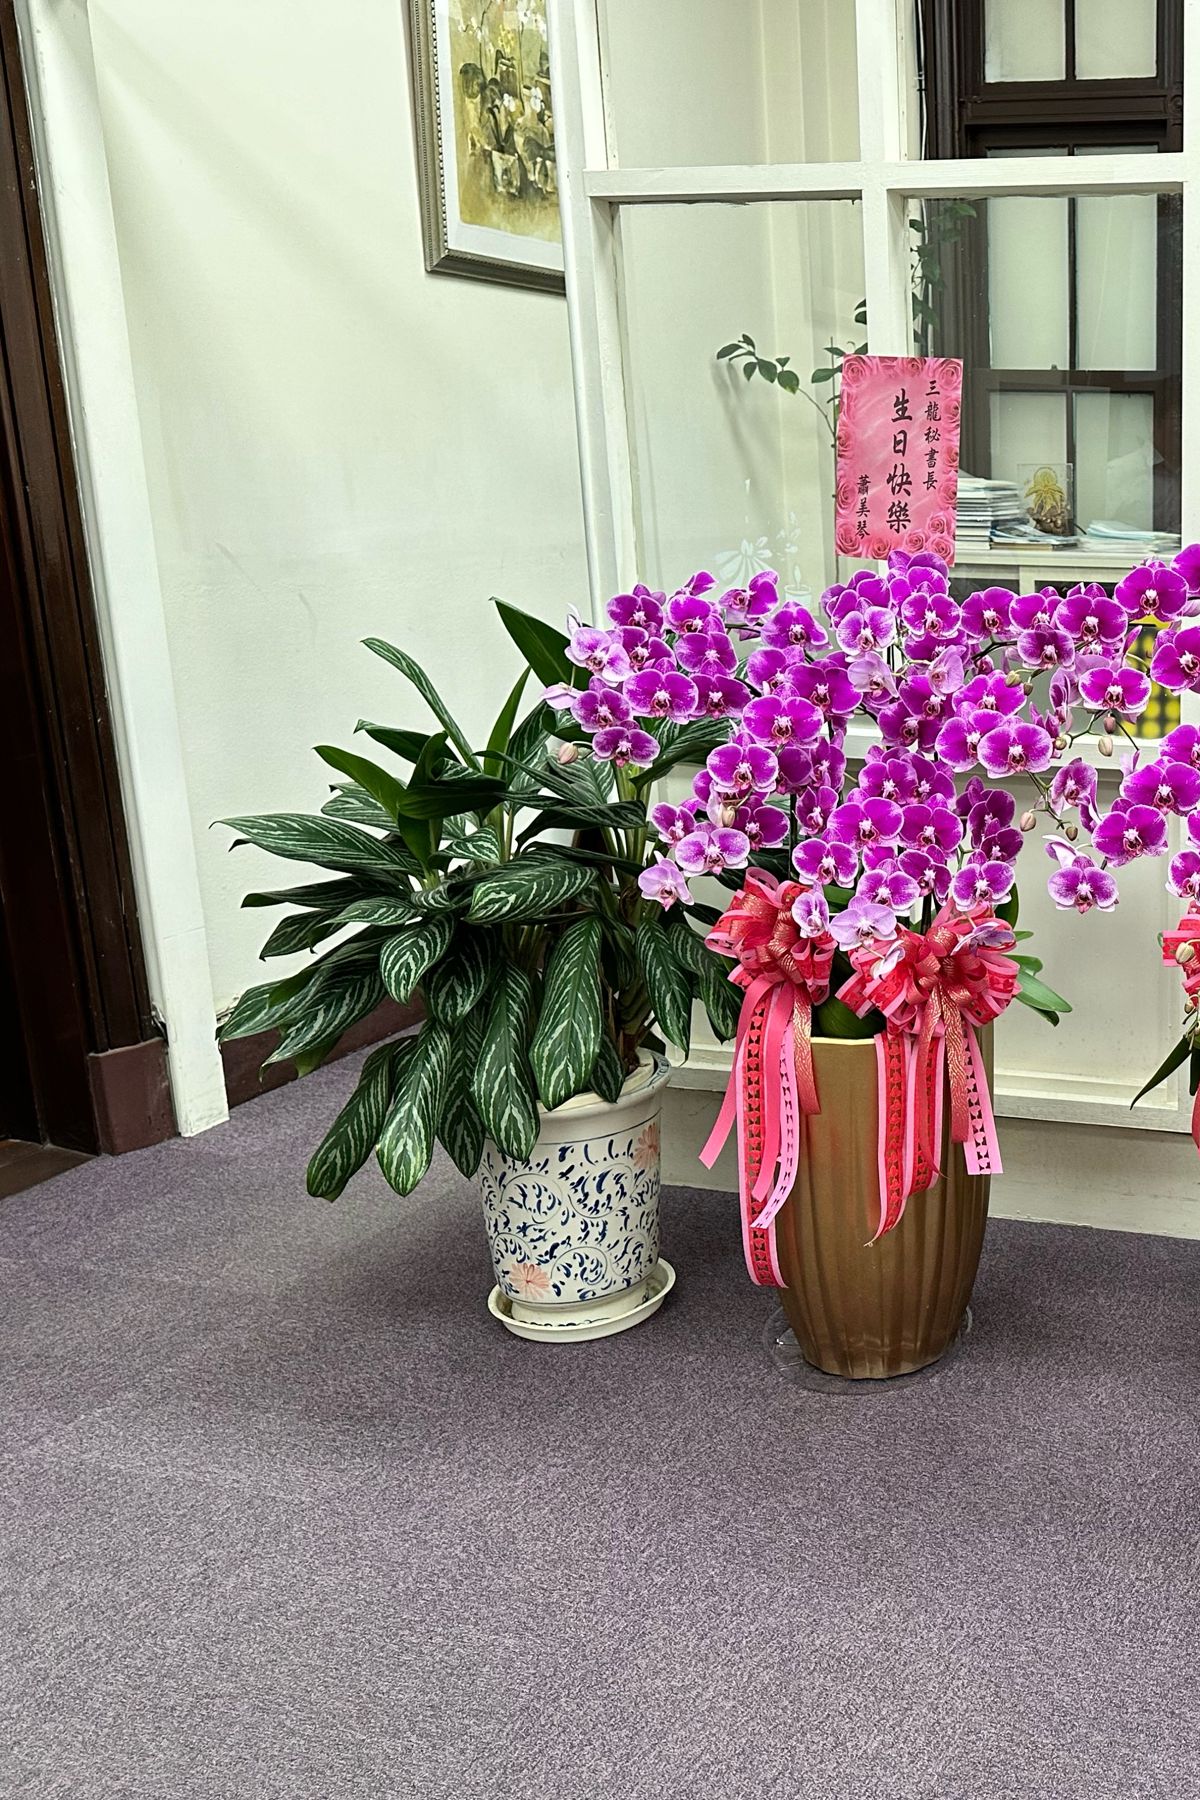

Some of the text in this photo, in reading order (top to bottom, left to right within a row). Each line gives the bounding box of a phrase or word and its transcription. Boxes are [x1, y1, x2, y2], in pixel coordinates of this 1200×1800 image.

[886, 387, 913, 534] 生日快樂
[923, 379, 942, 491] 三龍秘書長
[855, 474, 871, 540] 蕭美琴
